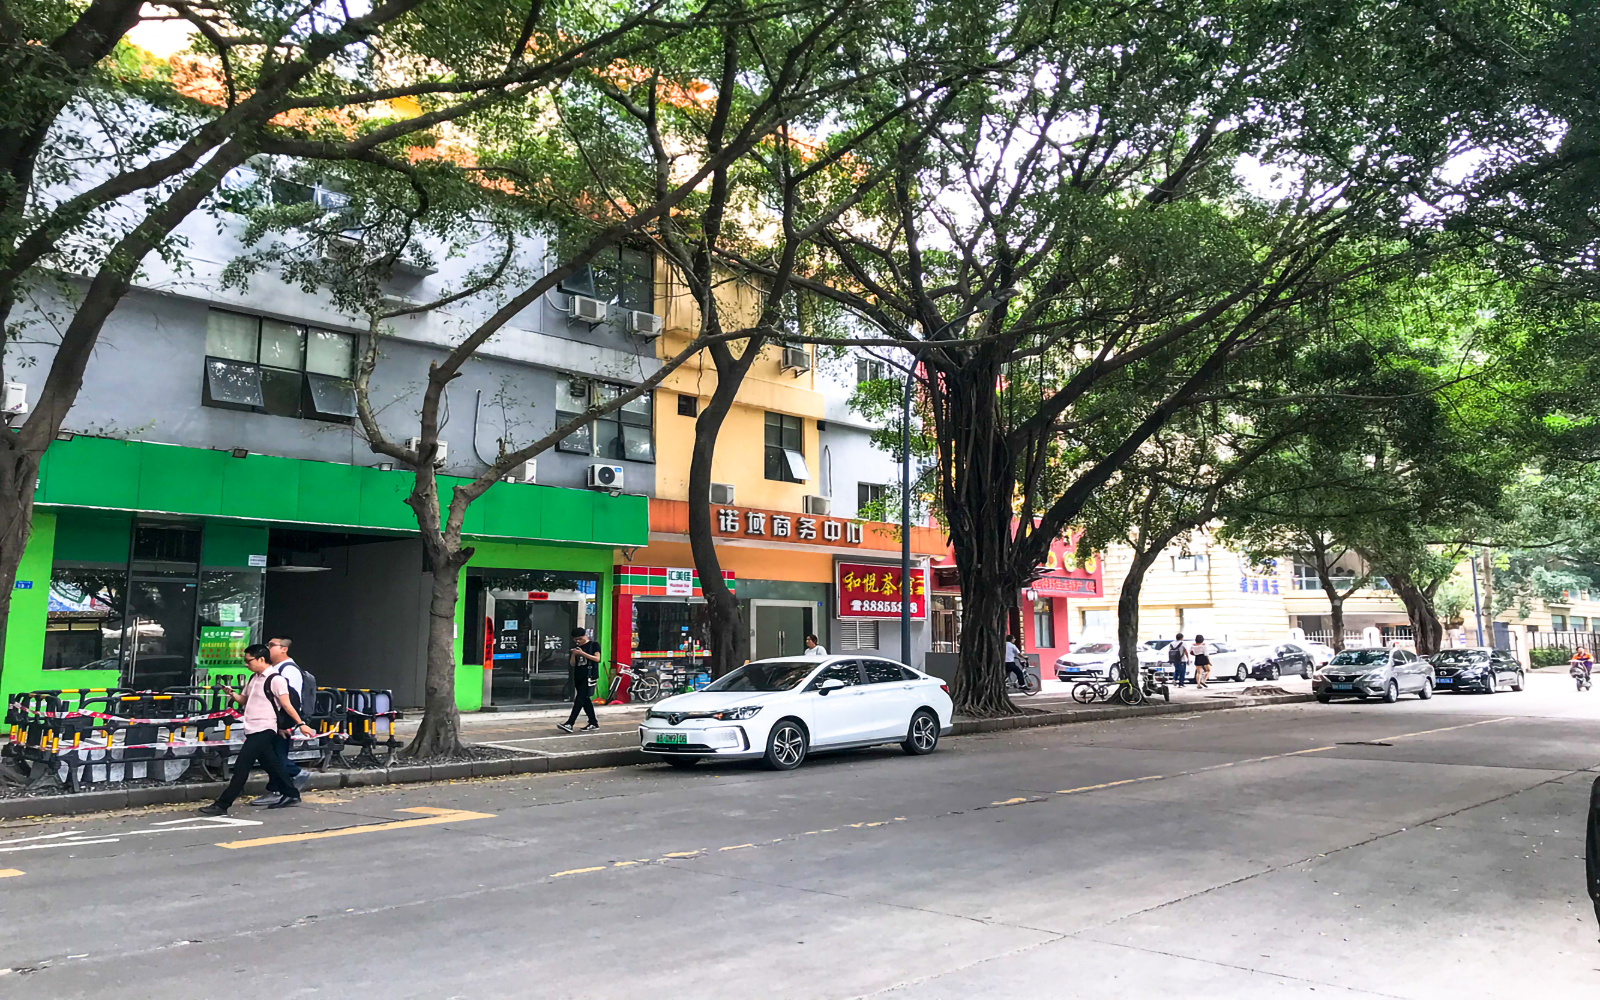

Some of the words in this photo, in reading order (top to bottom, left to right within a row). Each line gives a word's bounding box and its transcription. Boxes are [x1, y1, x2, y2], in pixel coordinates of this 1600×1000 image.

[718, 508, 864, 543] 诺域商务中心
[668, 570, 691, 582] 汇美佳
[862, 599, 918, 614] 8885588
